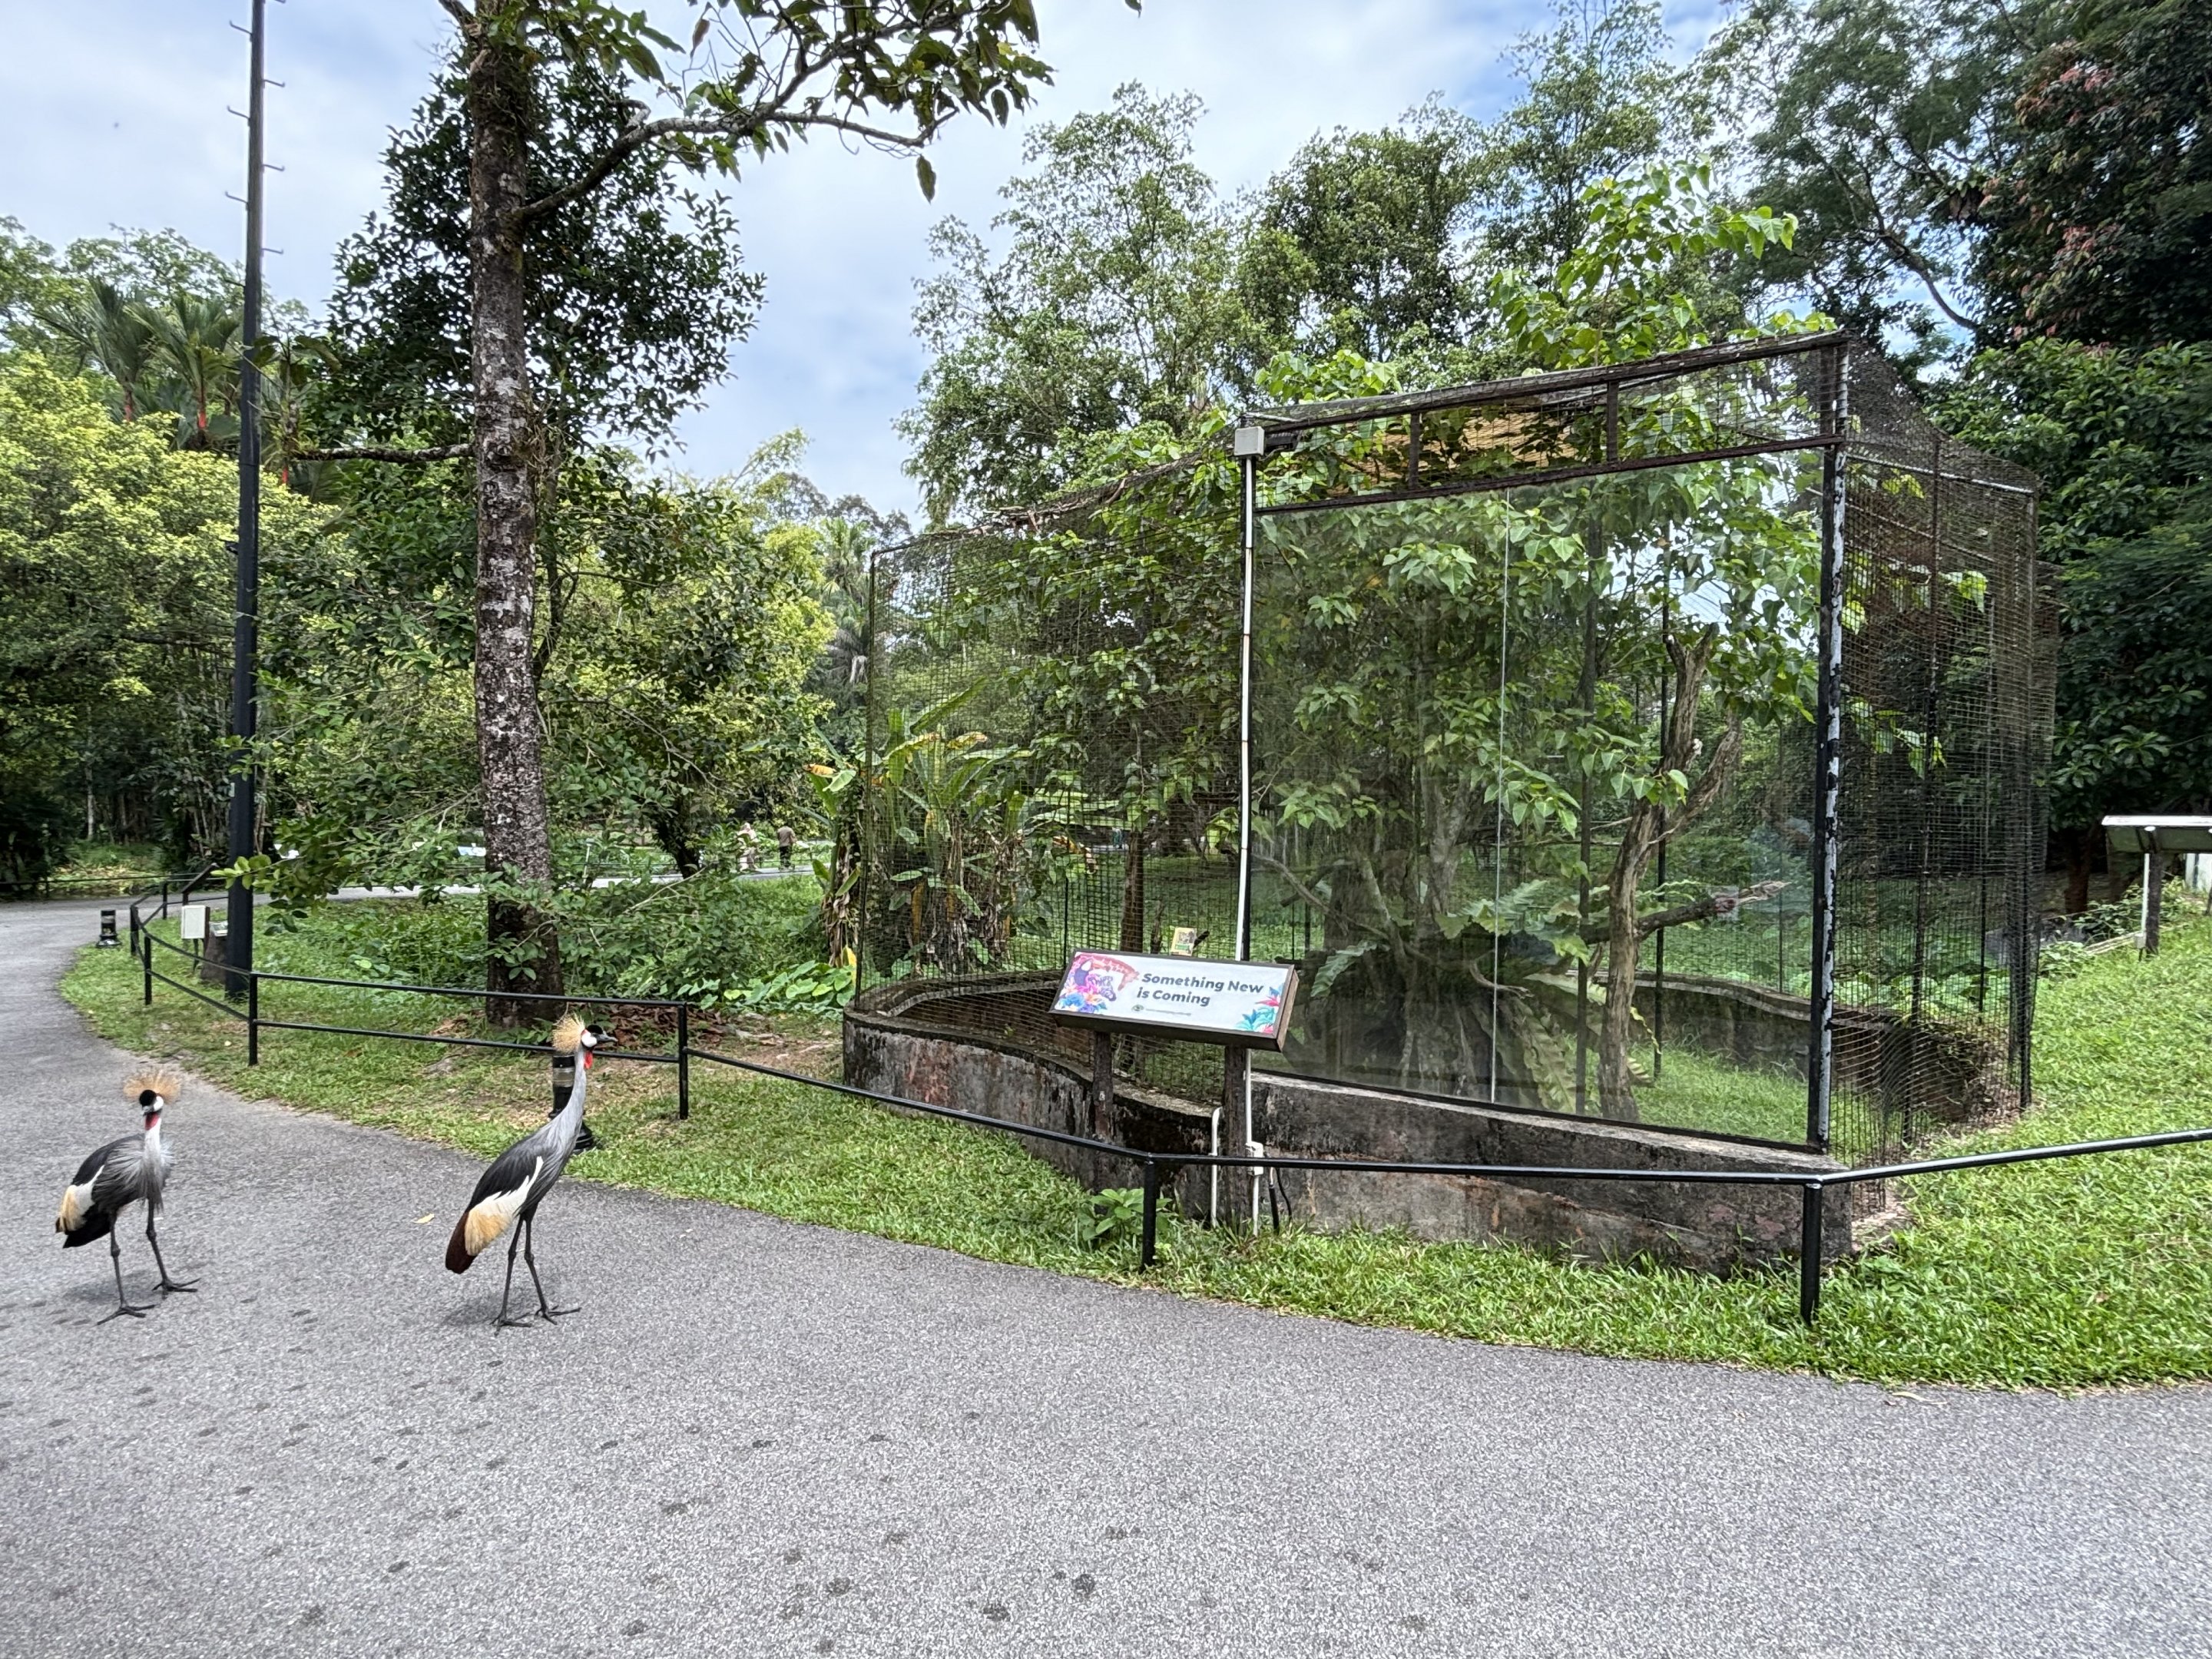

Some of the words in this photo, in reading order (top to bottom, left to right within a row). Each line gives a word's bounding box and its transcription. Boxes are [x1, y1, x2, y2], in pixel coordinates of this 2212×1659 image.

[1142, 973, 1224, 992] Something
[1228, 980, 1263, 993] New
[1137, 987, 1149, 998] is
[1153, 990, 1210, 1007] Coming
